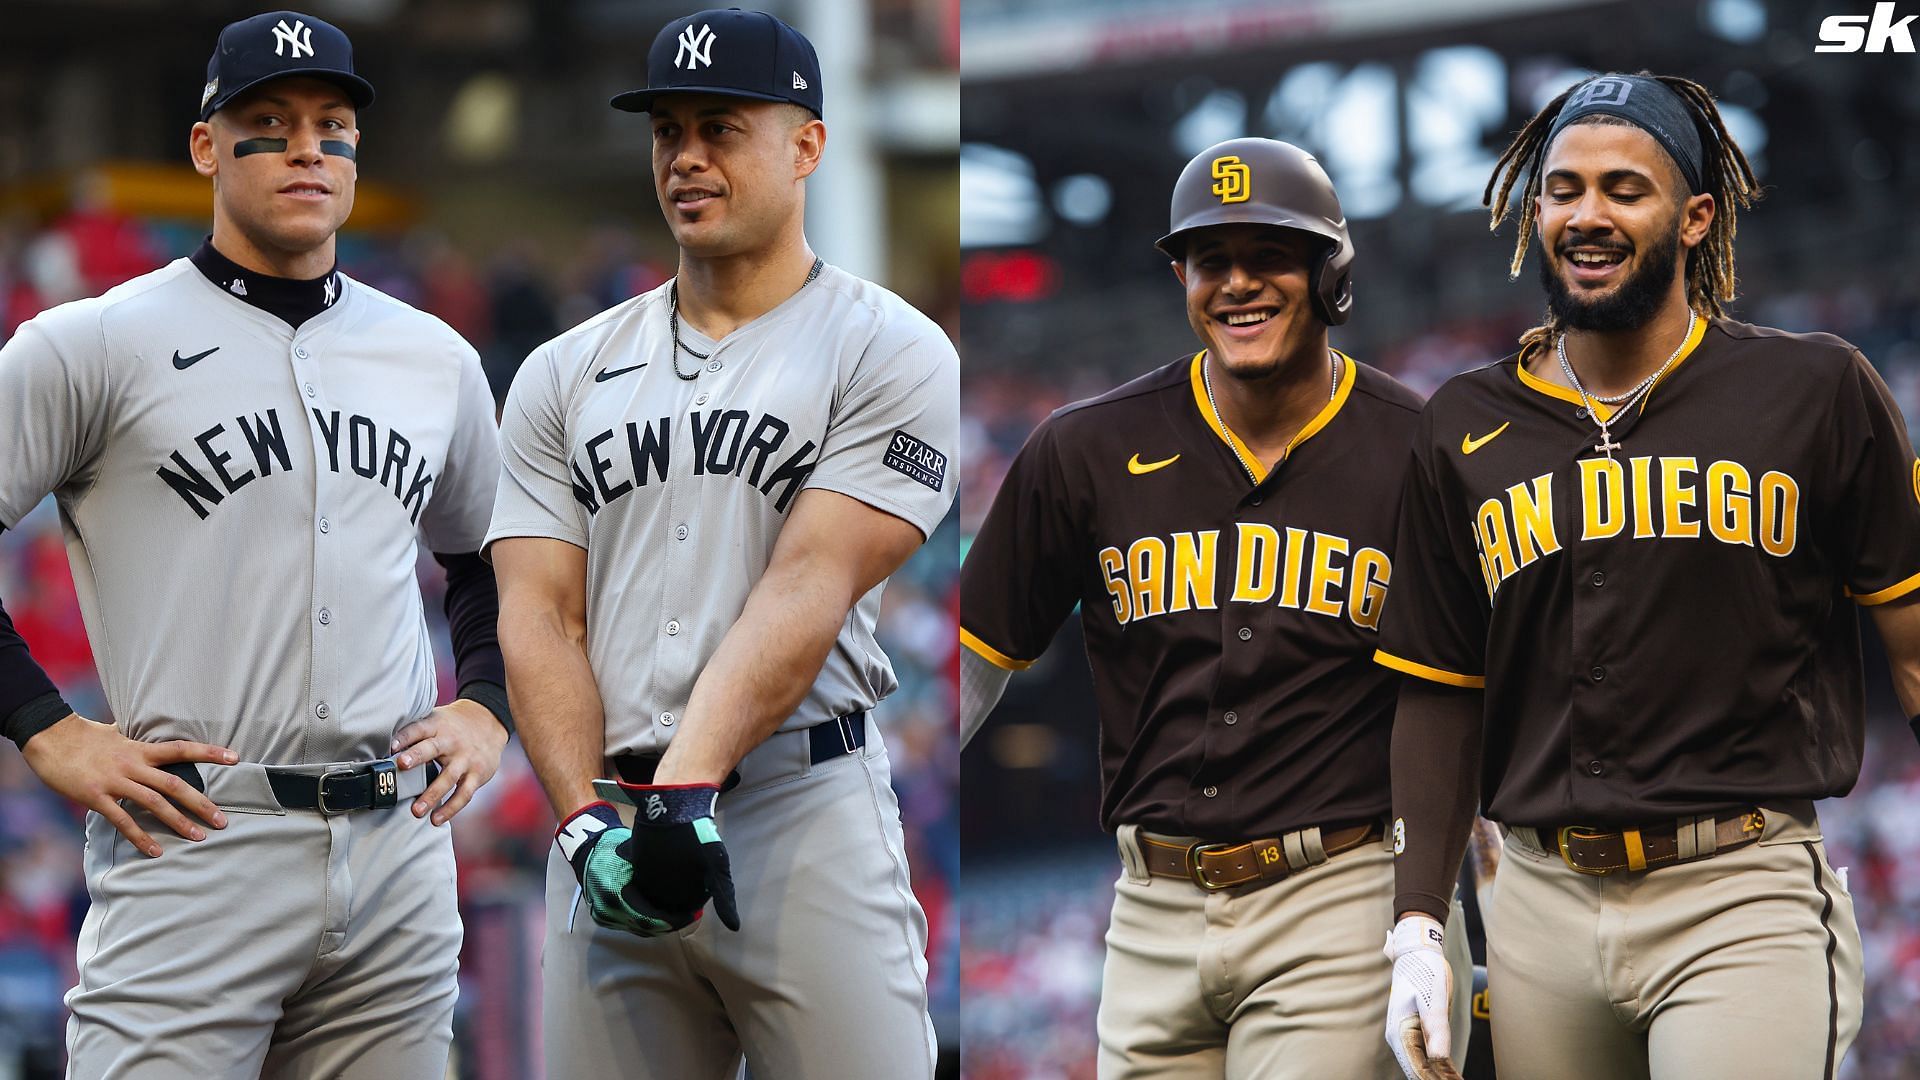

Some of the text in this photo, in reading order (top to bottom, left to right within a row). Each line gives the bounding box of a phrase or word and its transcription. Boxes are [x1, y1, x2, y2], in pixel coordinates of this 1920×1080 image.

[271, 19, 315, 58] NY
[673, 23, 718, 70] NY
[1212, 155, 1250, 205] SD
[156, 407, 433, 527] NEW YORK
[572, 409, 817, 517] NEW YORK
[887, 456, 940, 488] INSURANCE
[891, 435, 943, 476] STARR
[1576, 455, 1801, 558] DIEGO
[1099, 522, 1393, 631] SAN DIEG
[379, 771, 395, 796] 99
[1393, 817, 1406, 855] 3
[1740, 812, 1764, 832] 23
[1260, 846, 1280, 865] 13
